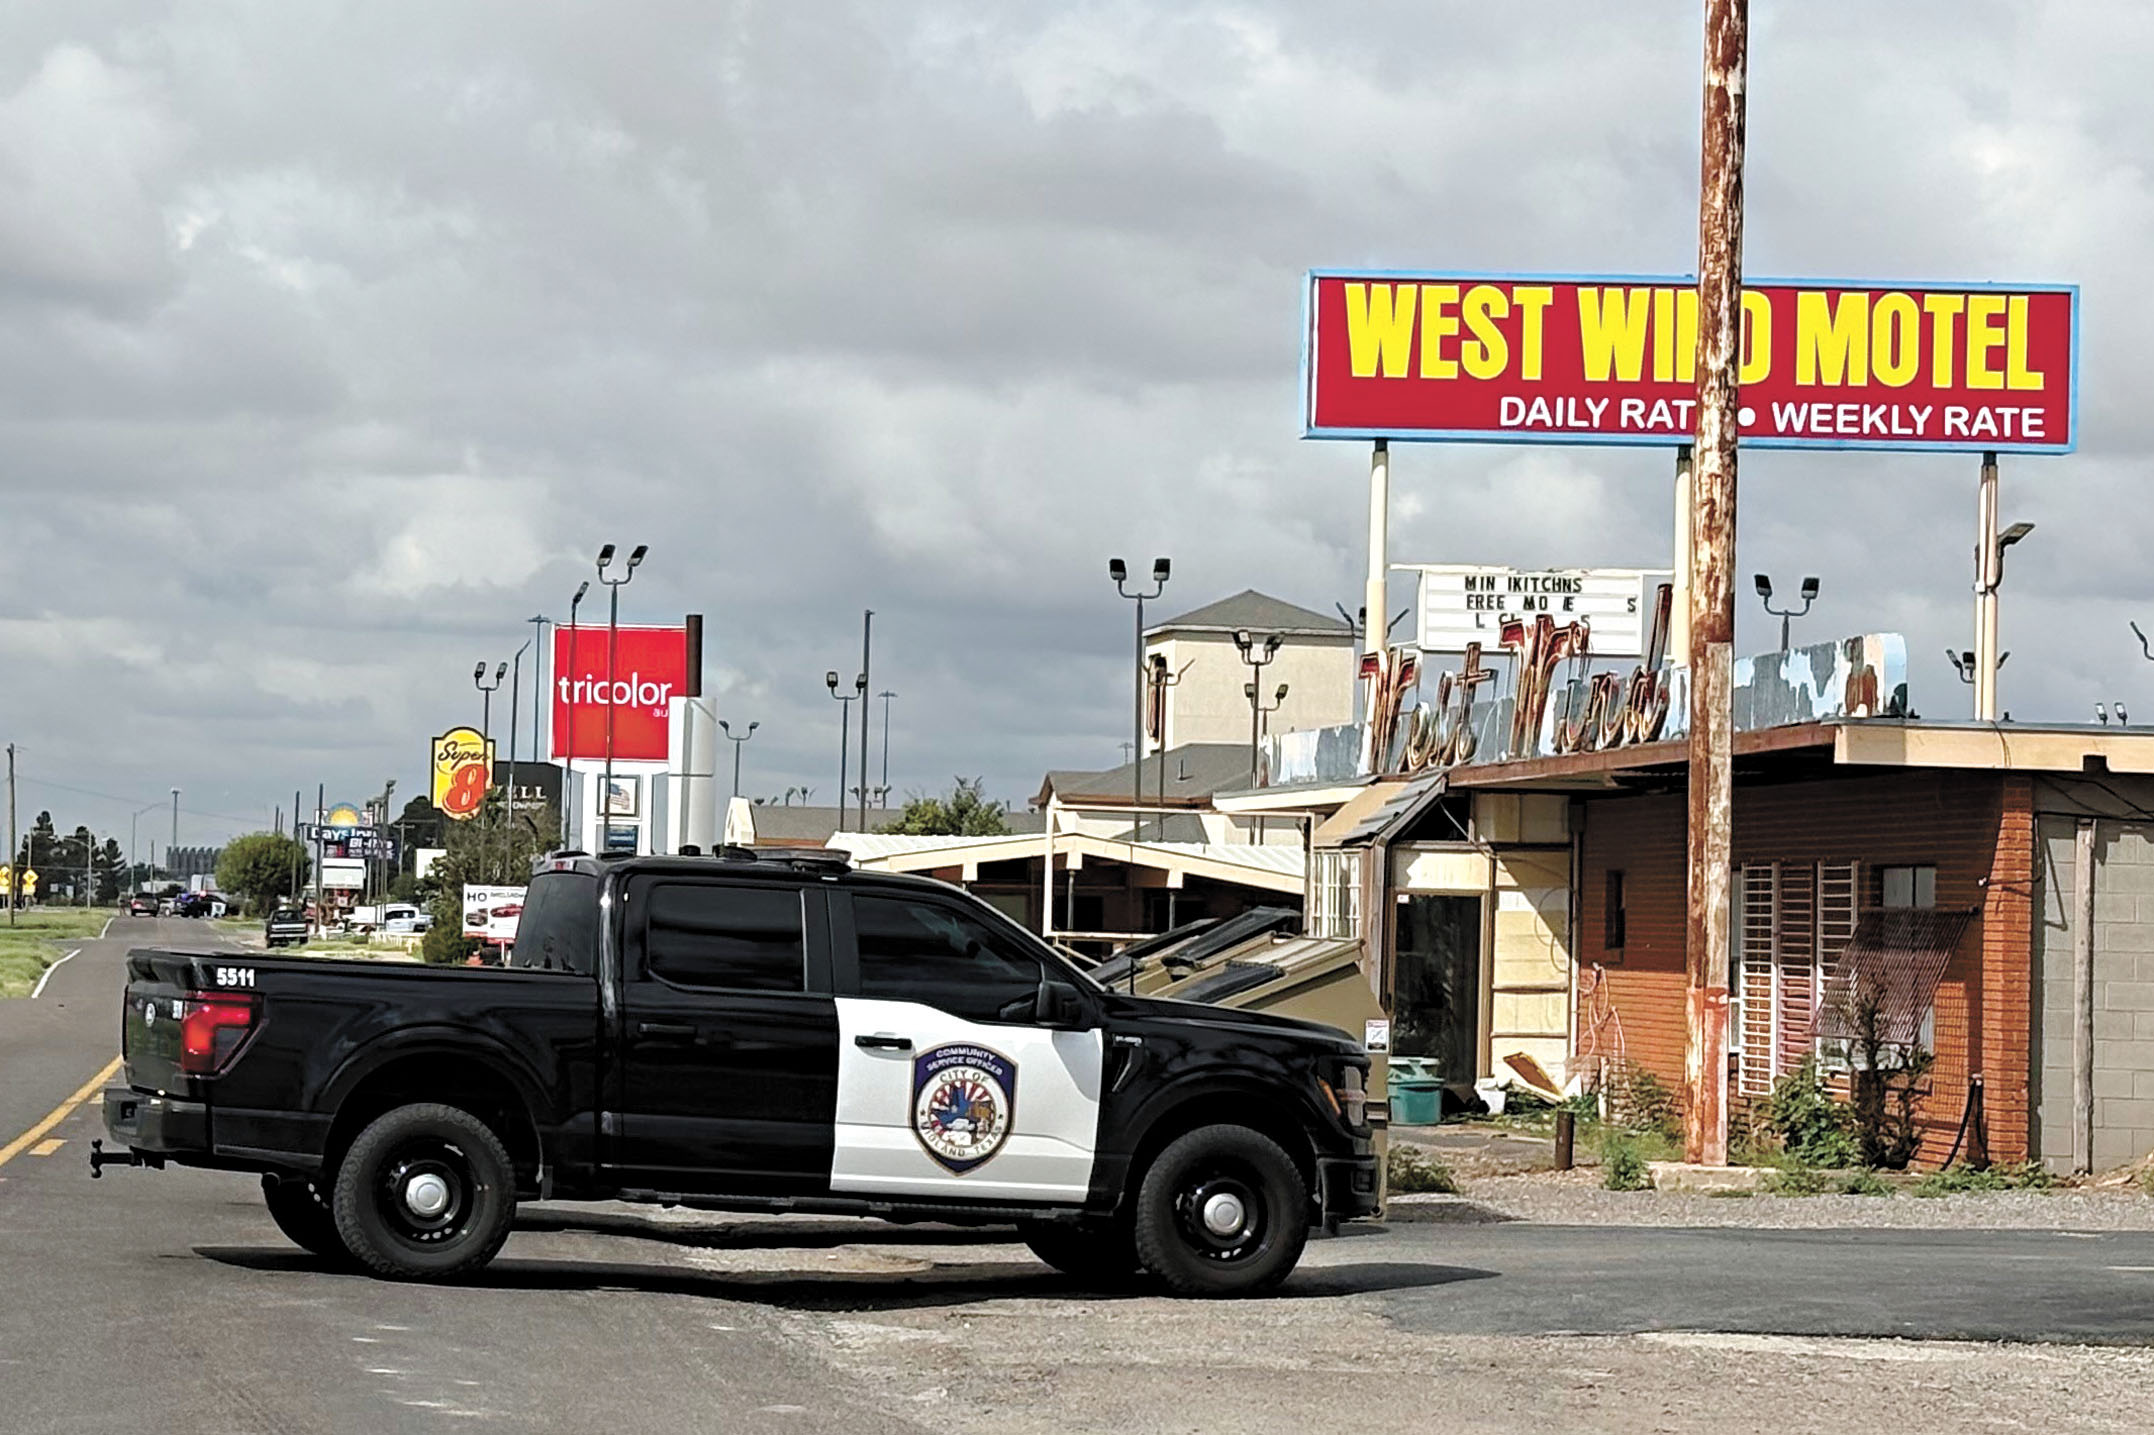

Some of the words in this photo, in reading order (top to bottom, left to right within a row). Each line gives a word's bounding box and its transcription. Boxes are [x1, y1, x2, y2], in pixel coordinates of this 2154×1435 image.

[1344, 282, 1554, 381] WEST
[1796, 291, 2045, 391] MOTEL
[1500, 396, 1610, 429] DAILY
[1620, 399, 1697, 431] RAT
[1771, 402, 1934, 437] WEEKLY
[1943, 406, 2046, 438] RATE
[1465, 576, 1496, 592] MIN
[1466, 594, 1506, 610] FREE
[558, 671, 673, 708] tricolor
[437, 740, 490, 771] Super
[444, 763, 489, 814] 8
[216, 967, 256, 987] 5511
[936, 1047, 996, 1061] COMMUNITY
[926, 1056, 964, 1072] SERVICE
[965, 1056, 1003, 1076] OFFICER
[939, 1069, 968, 1082] CITY
[972, 1071, 991, 1083] OF
